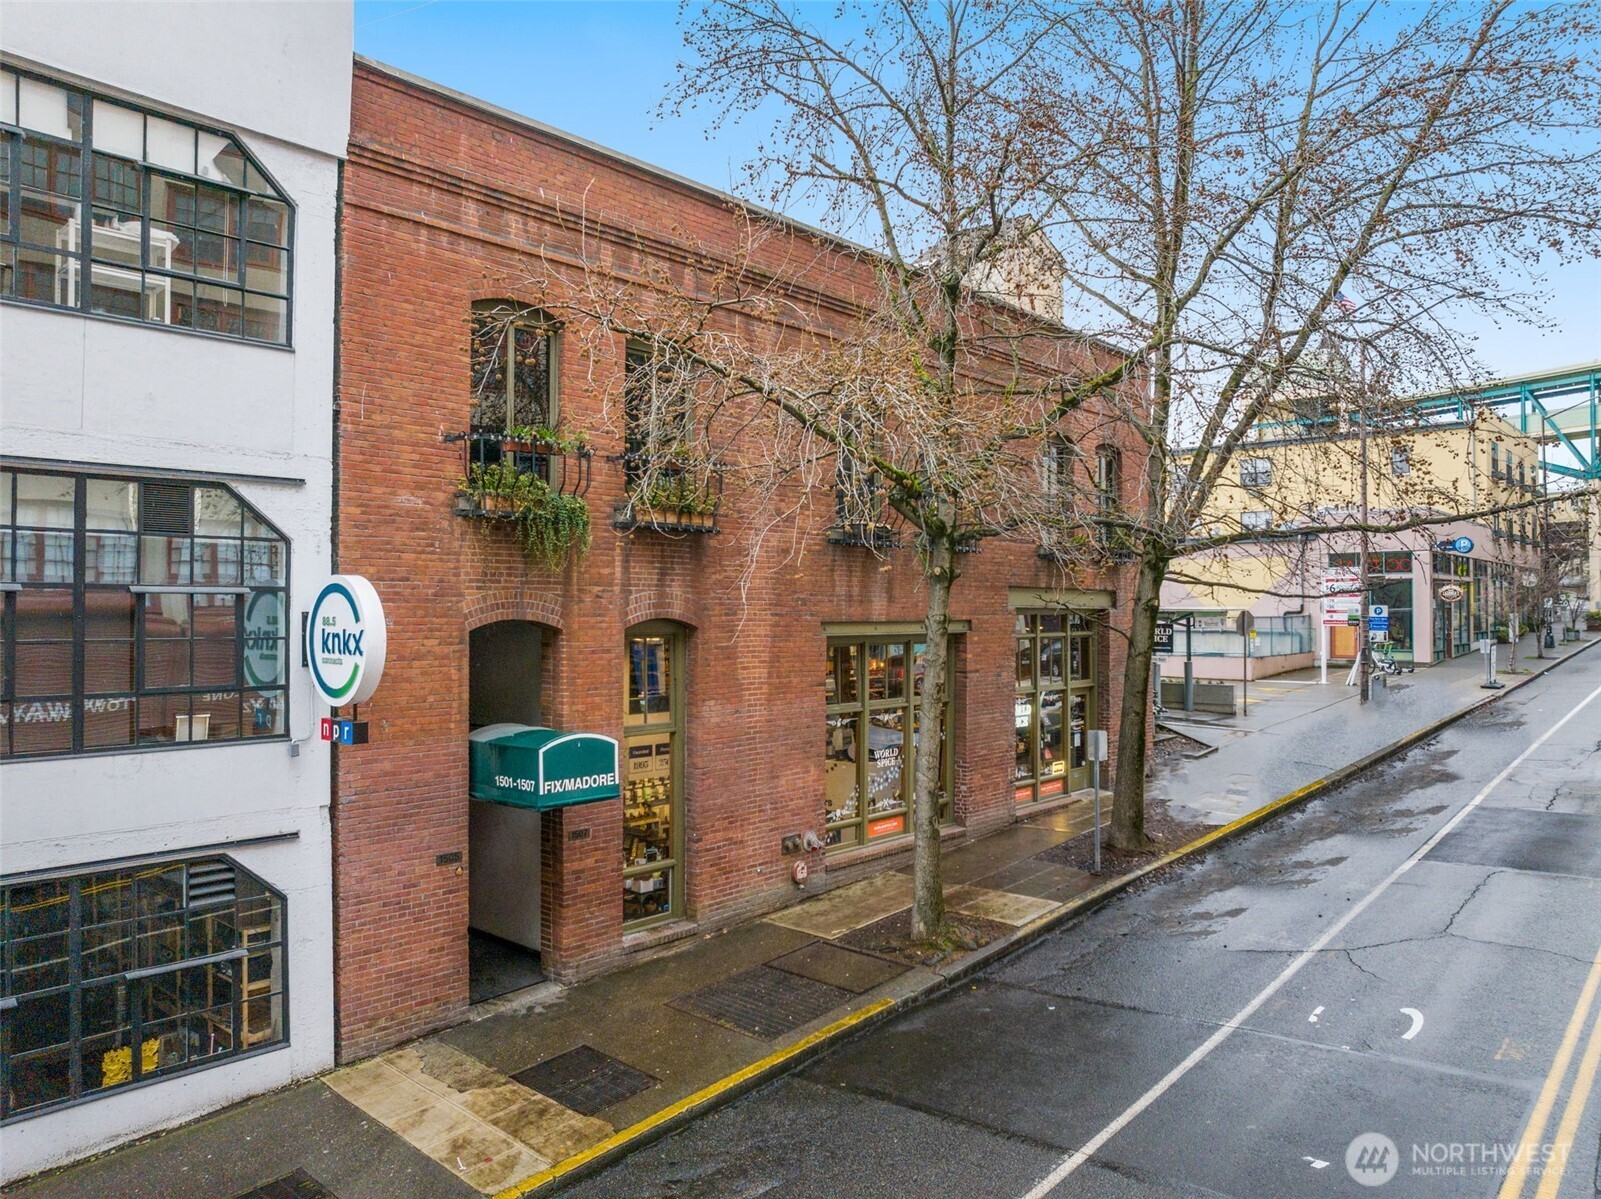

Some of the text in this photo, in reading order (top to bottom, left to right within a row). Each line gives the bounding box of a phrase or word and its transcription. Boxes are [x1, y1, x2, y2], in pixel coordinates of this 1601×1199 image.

[321, 616, 337, 627] 88.5
[321, 628, 365, 657] knkx
[322, 722, 350, 742] npr
[873, 747, 899, 760] WORLD
[876, 757, 896, 768] SPICE
[494, 774, 536, 793] 1501-1507
[544, 772, 615, 795] FIX/MADORE
[571, 829, 588, 840] 1507
[439, 853, 460, 864] 1505
